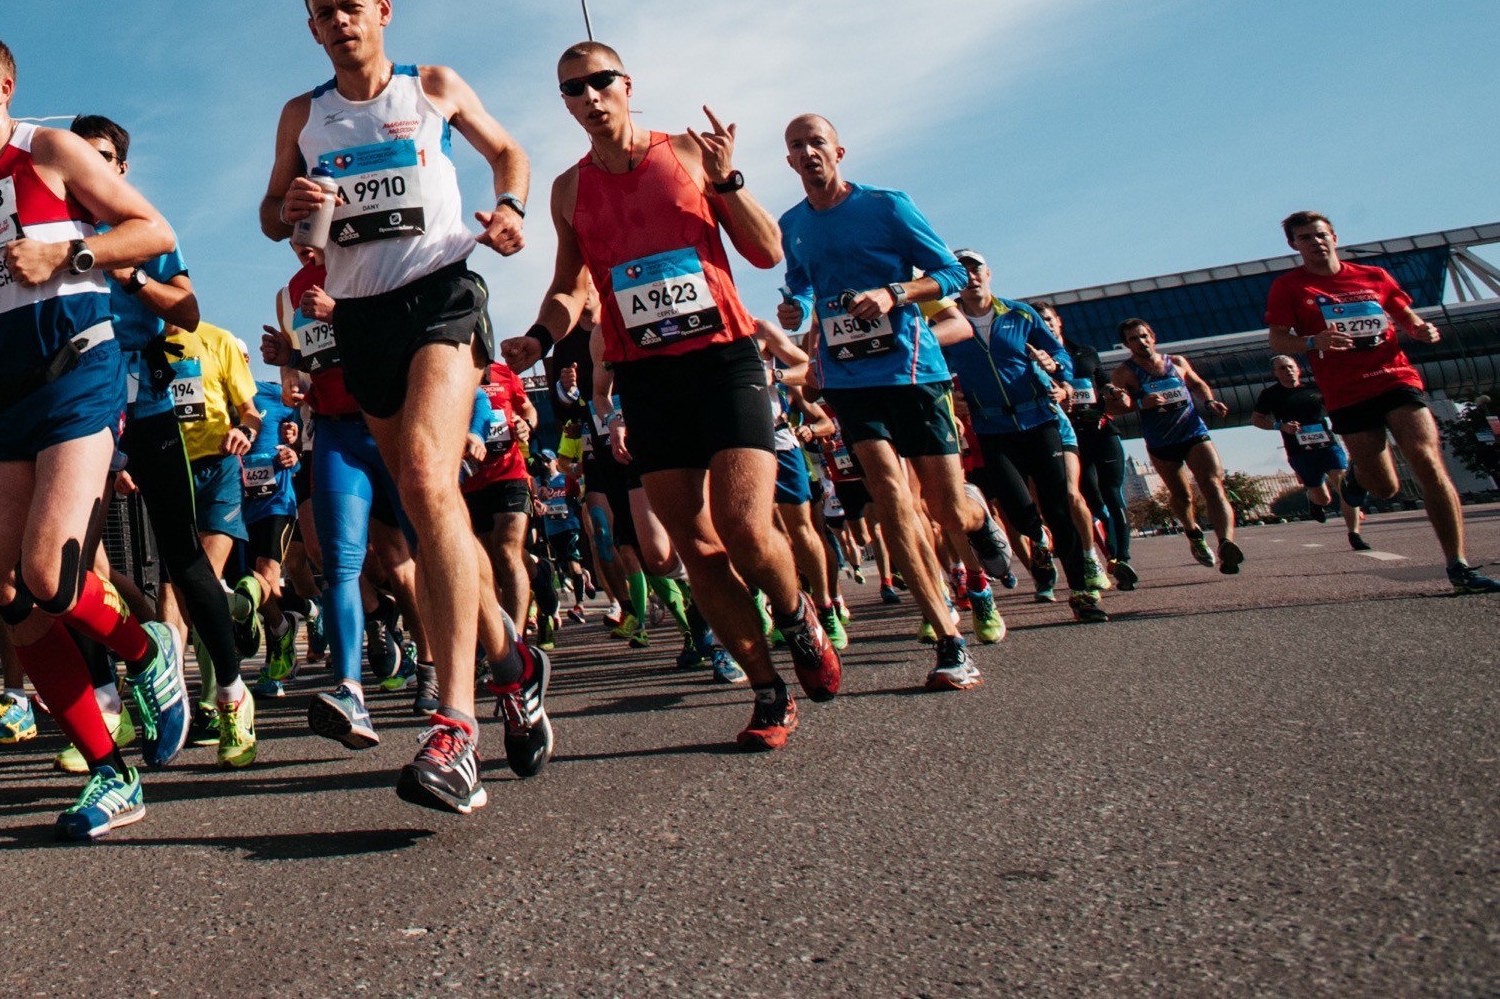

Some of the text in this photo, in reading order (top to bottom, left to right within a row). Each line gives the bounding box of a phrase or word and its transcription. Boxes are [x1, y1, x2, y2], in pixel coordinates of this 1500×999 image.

[353, 175, 406, 203] 9910
[362, 203, 380, 212] DANY
[338, 231, 360, 242] adidas
[632, 282, 698, 315] A 9623
[832, 321, 844, 337] A
[1348, 318, 1381, 332] 2799
[305, 330, 314, 347] A
[246, 469, 270, 481] 4622
